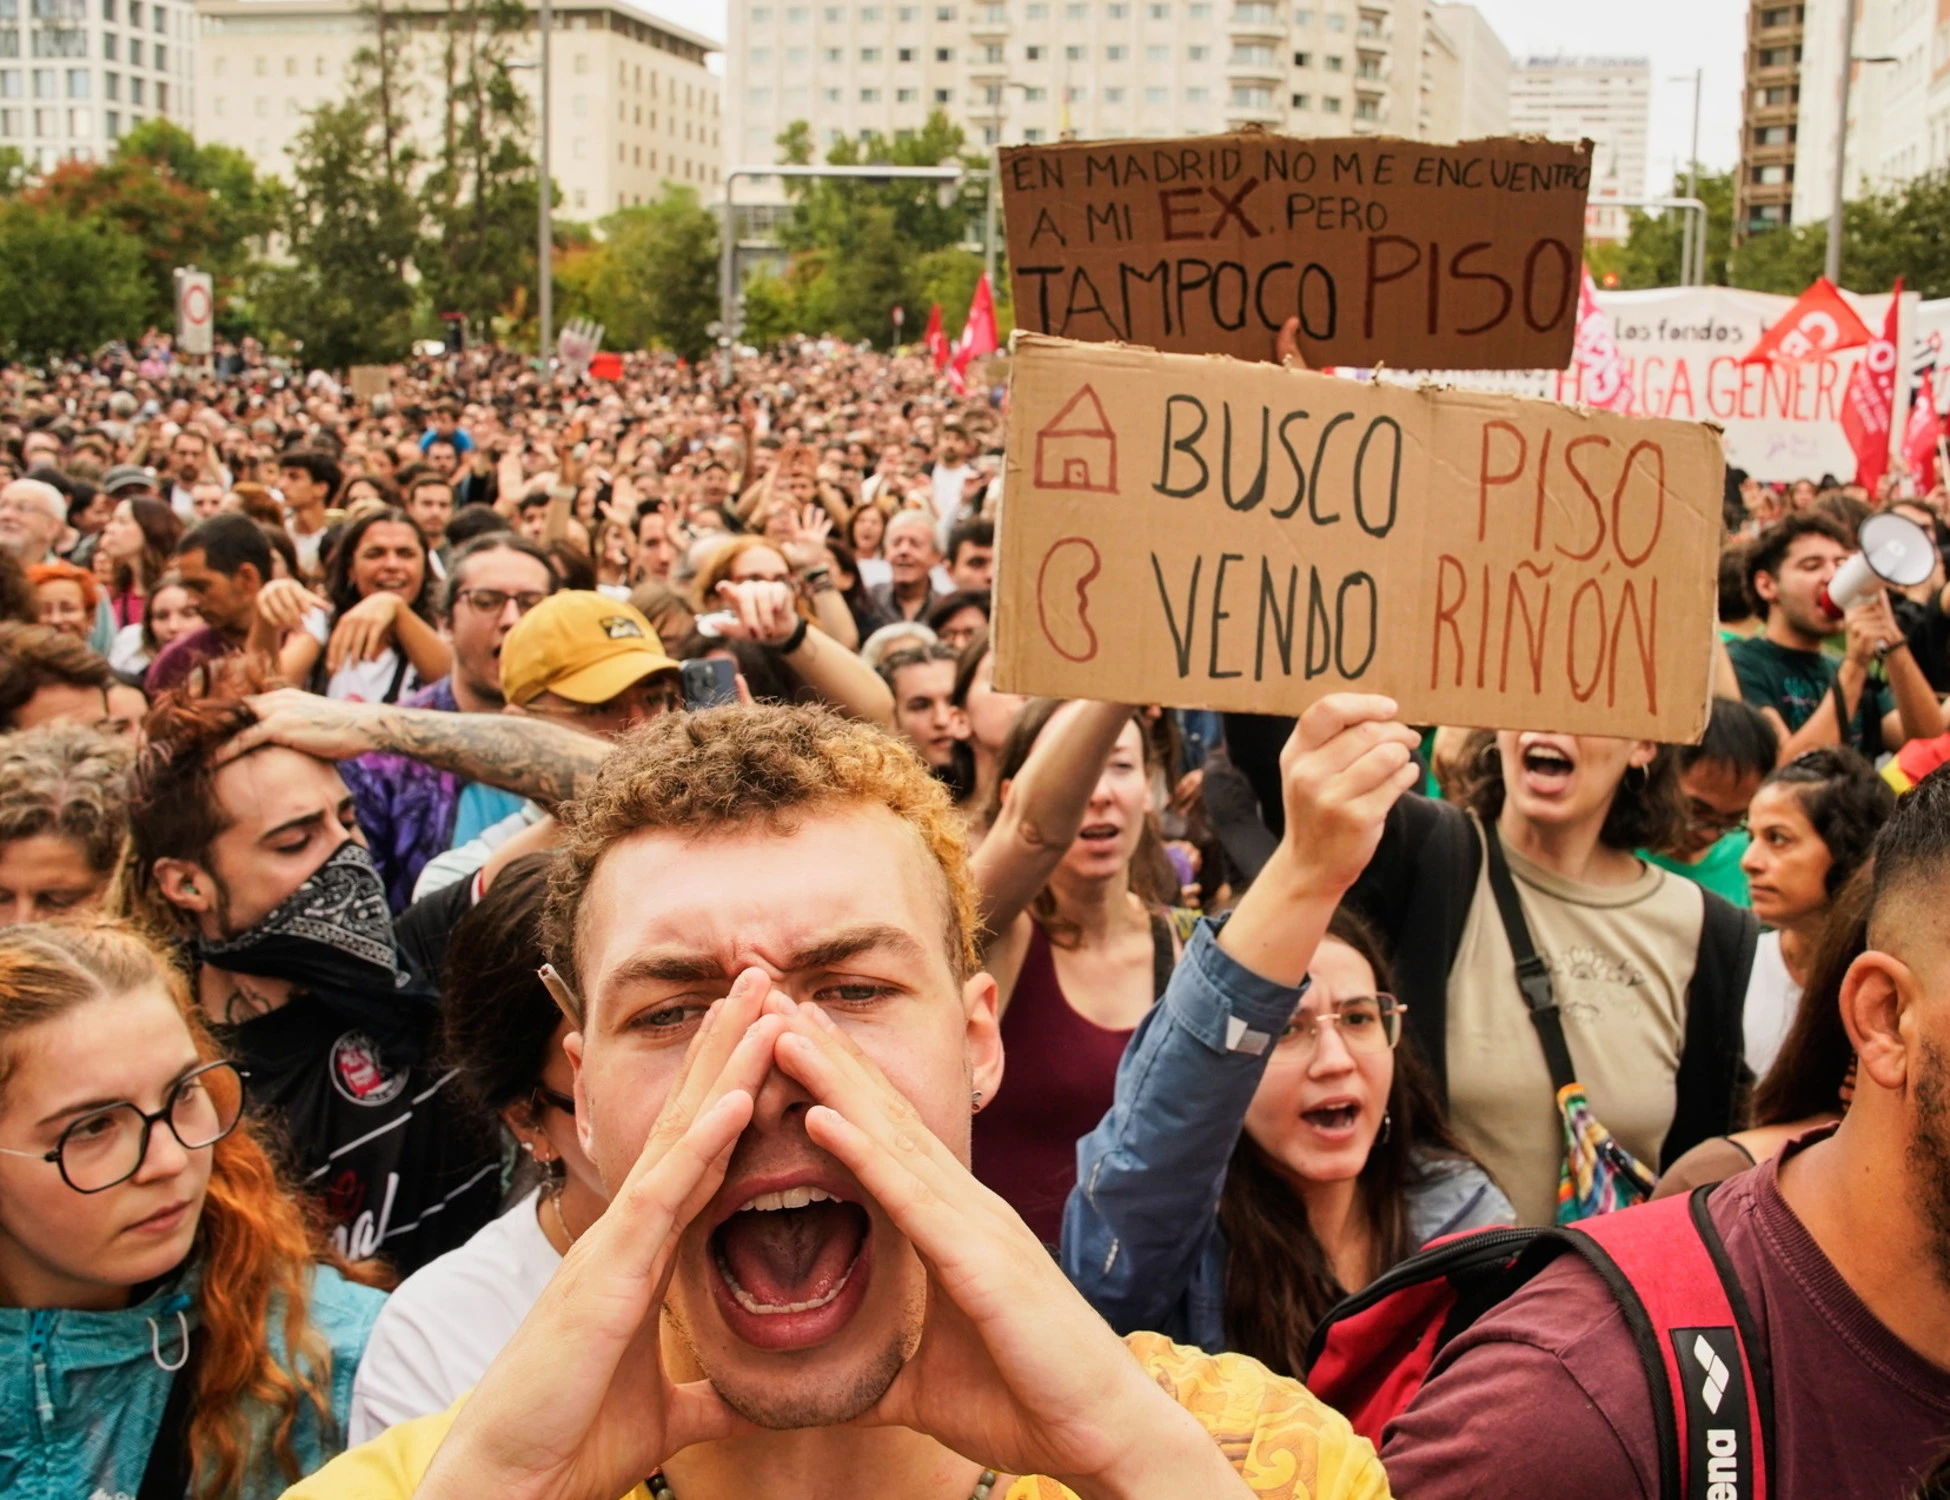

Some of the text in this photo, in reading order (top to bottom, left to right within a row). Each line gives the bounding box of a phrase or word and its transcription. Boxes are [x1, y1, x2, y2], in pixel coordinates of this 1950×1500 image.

[1011, 148, 1592, 193] EN MADRID NO ME ENCUENTRO
[1028, 207, 1068, 248] A
[1085, 202, 1134, 243] MI
[1285, 193, 1389, 232] PERO
[1016, 234, 1577, 342] TAMPOCO PISO
[1706, 354, 1846, 422] GENER
[1150, 393, 1667, 569] BUSCO PISO
[1150, 551, 1660, 716] VENDO RIÑÓN
